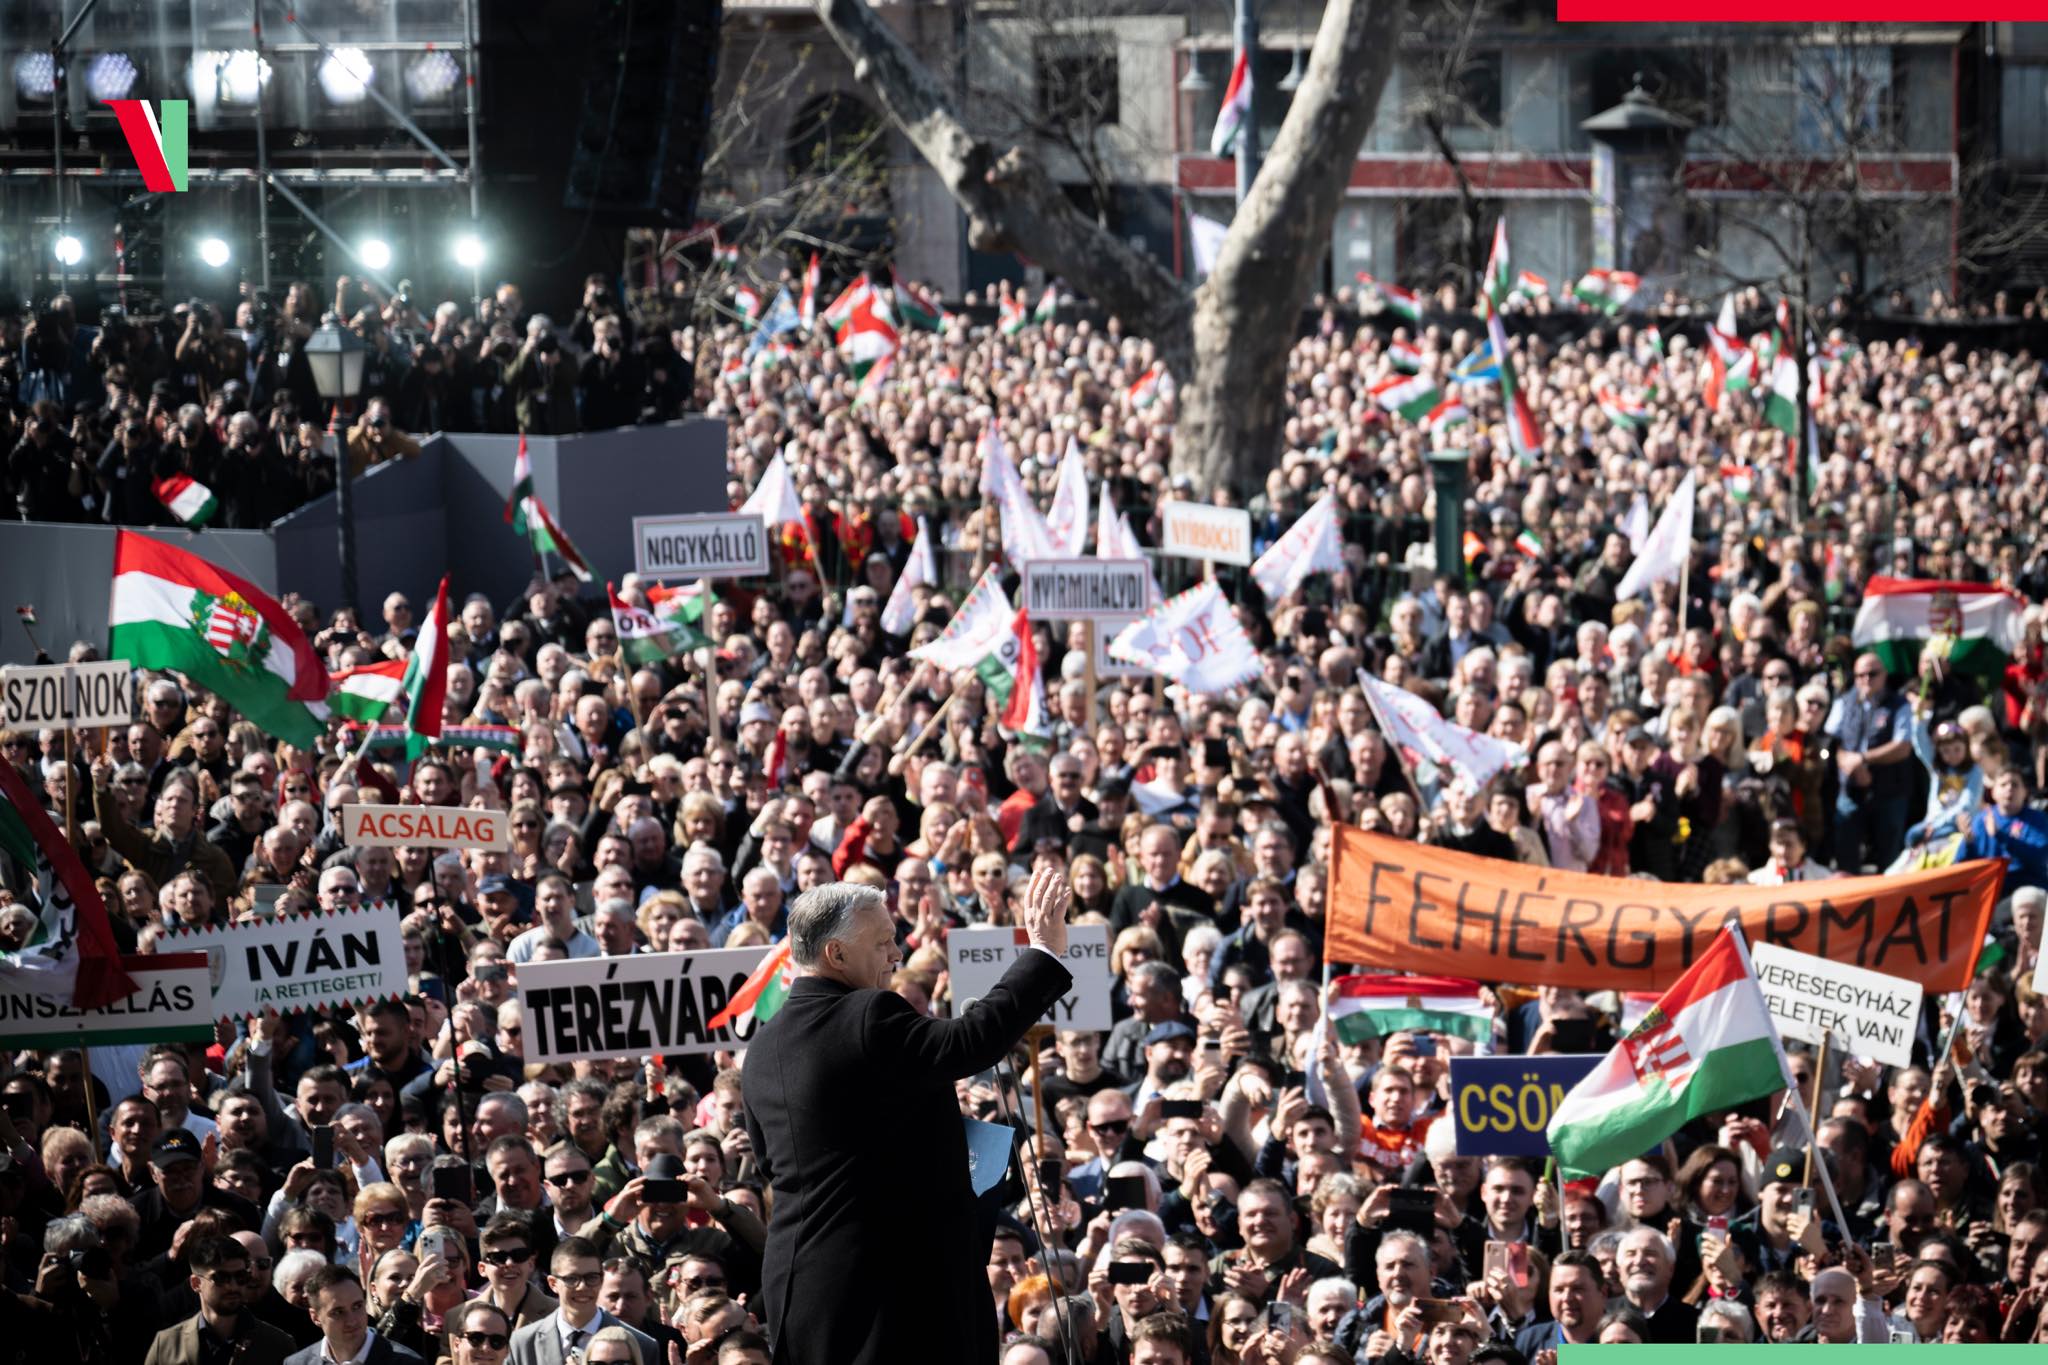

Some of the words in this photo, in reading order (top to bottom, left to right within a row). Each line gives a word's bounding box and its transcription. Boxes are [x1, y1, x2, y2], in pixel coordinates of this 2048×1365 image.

[647, 526, 756, 566] NAGYKÁLLÓ
[7, 671, 128, 723] SZOLNOK
[357, 813, 494, 842] ACSALAG
[246, 928, 381, 981] IVÁN
[959, 948, 1004, 963] PEST
[276, 972, 382, 999] RETTEGETT/
[525, 958, 764, 1056] TERÉZVÁRO
[1755, 962, 1912, 1019] VERESEGYHÁZ
[1763, 994, 1848, 1032] ELETEK
[1856, 1017, 1904, 1047] VAN!
